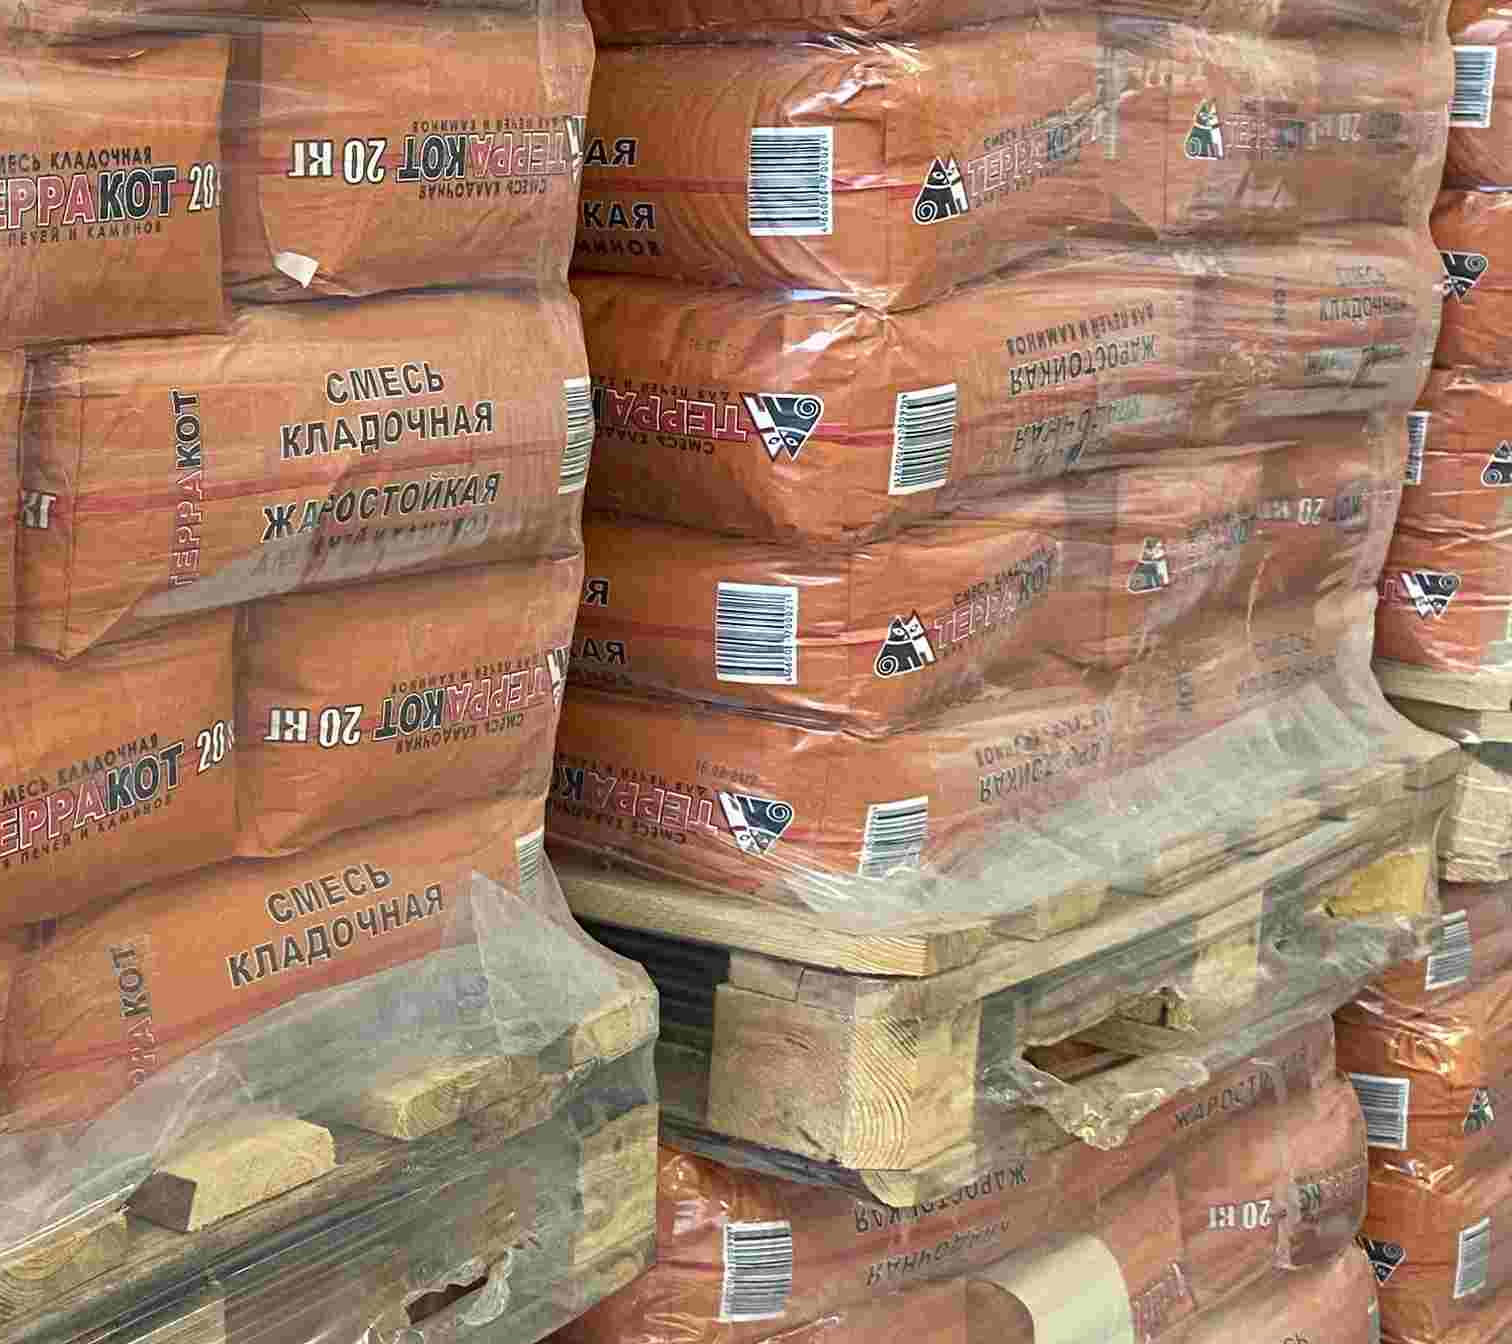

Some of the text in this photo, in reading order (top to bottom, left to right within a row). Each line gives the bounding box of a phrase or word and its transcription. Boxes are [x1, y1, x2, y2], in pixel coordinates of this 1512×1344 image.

[49, 146, 153, 171] КЛАДОЧНАЯ
[288, 137, 385, 182] КГ 20
[396, 132, 567, 184] ТЕРРАКОТ
[188, 163, 215, 213] 20
[7, 231, 59, 248] ПЕЧЕЙ
[86, 222, 163, 241] КАМИНОВ
[325, 360, 445, 405] СМЕСЬ
[280, 399, 495, 459] КЛАДОЧНАЯ
[169, 387, 203, 587] ТЕРРАКОТ
[261, 470, 501, 543] ЖАРОСТОЙКАЯ
[263, 704, 363, 749] КГ 20
[373, 661, 550, 742] ТЕРРАКОТ
[56, 733, 158, 784] КЛАДОЧНАЯ
[195, 722, 225, 773] 20
[265, 863, 393, 926] СМЕСЬ
[225, 884, 445, 989] КЛАДОЧНАЯ
[1243, 1201, 1272, 1229] 20
